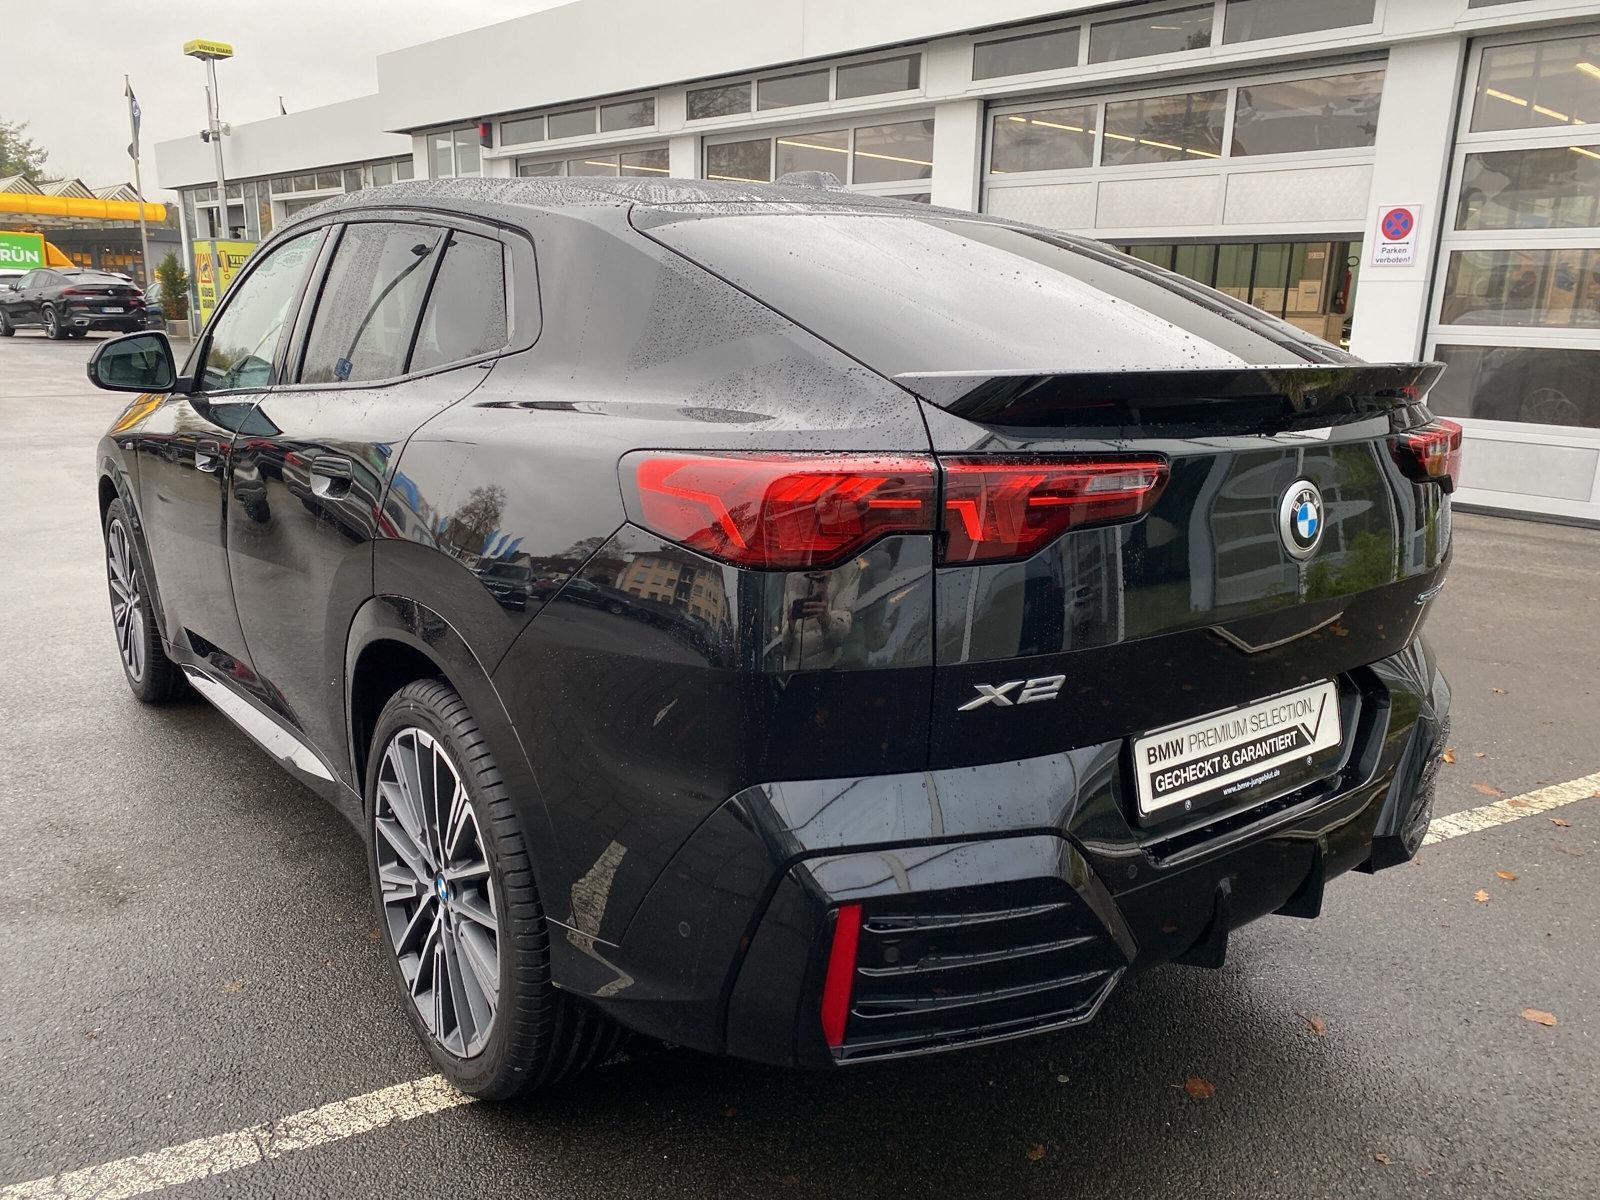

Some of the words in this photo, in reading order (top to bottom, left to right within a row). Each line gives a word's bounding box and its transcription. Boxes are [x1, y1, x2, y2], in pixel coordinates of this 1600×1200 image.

[1292, 491, 1320, 513] BMW
[957, 674, 1066, 711] X2
[1147, 737, 1185, 766] BMW
[1188, 717, 1249, 753] PREMIUM
[1249, 697, 1315, 734] SELECTION.
[1154, 756, 1222, 793] GECHECKT
[1222, 753, 1231, 771] &
[1231, 730, 1299, 767] GARANTIERT
[1222, 768, 1281, 796] www.bmw-jungeblut.de
